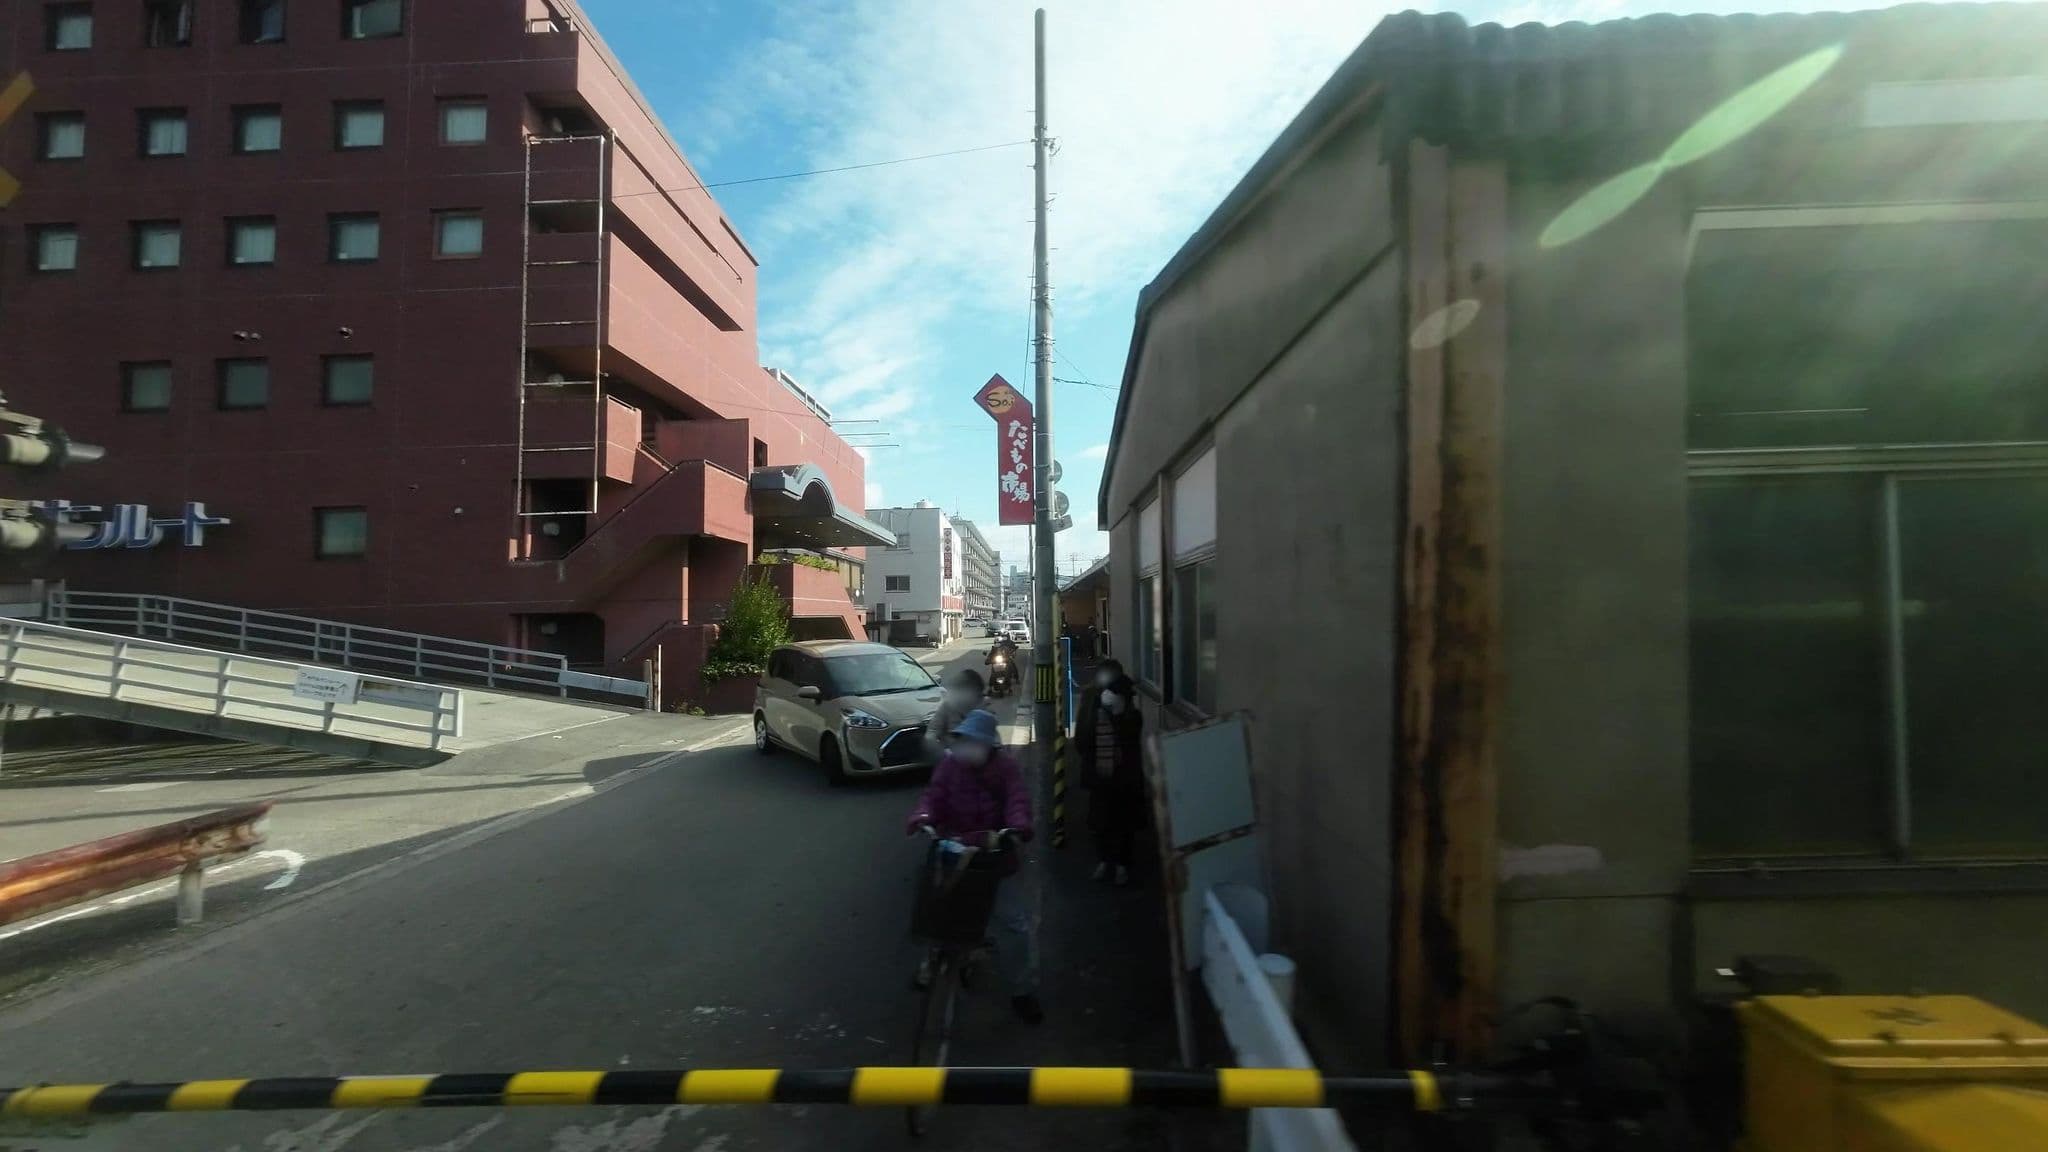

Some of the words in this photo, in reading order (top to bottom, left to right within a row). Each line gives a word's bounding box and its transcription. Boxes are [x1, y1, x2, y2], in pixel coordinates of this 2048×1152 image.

[1001, 420, 1030, 503] たべもの市場
